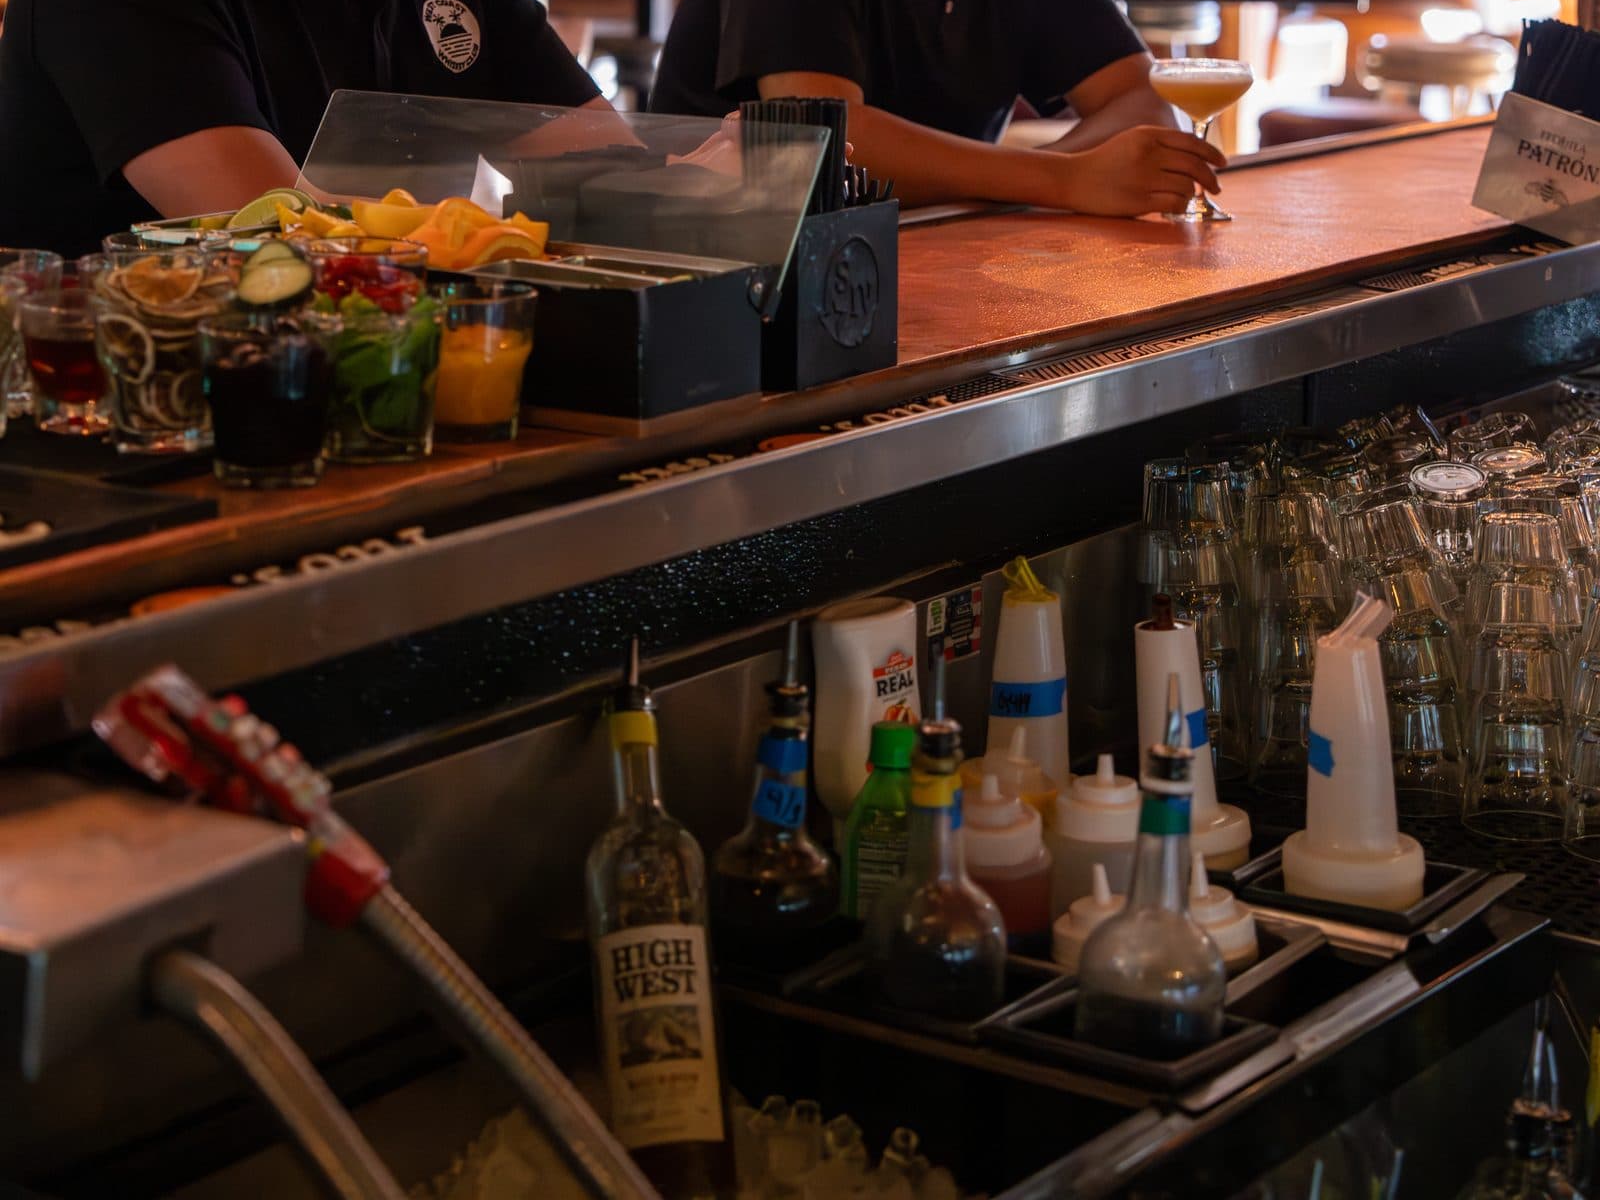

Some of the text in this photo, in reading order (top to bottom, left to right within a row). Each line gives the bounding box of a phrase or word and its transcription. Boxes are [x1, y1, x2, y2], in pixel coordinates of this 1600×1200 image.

[435, 0, 467, 13] COAST
[611, 939, 695, 975] HIGH
[614, 969, 697, 1002] WEST
